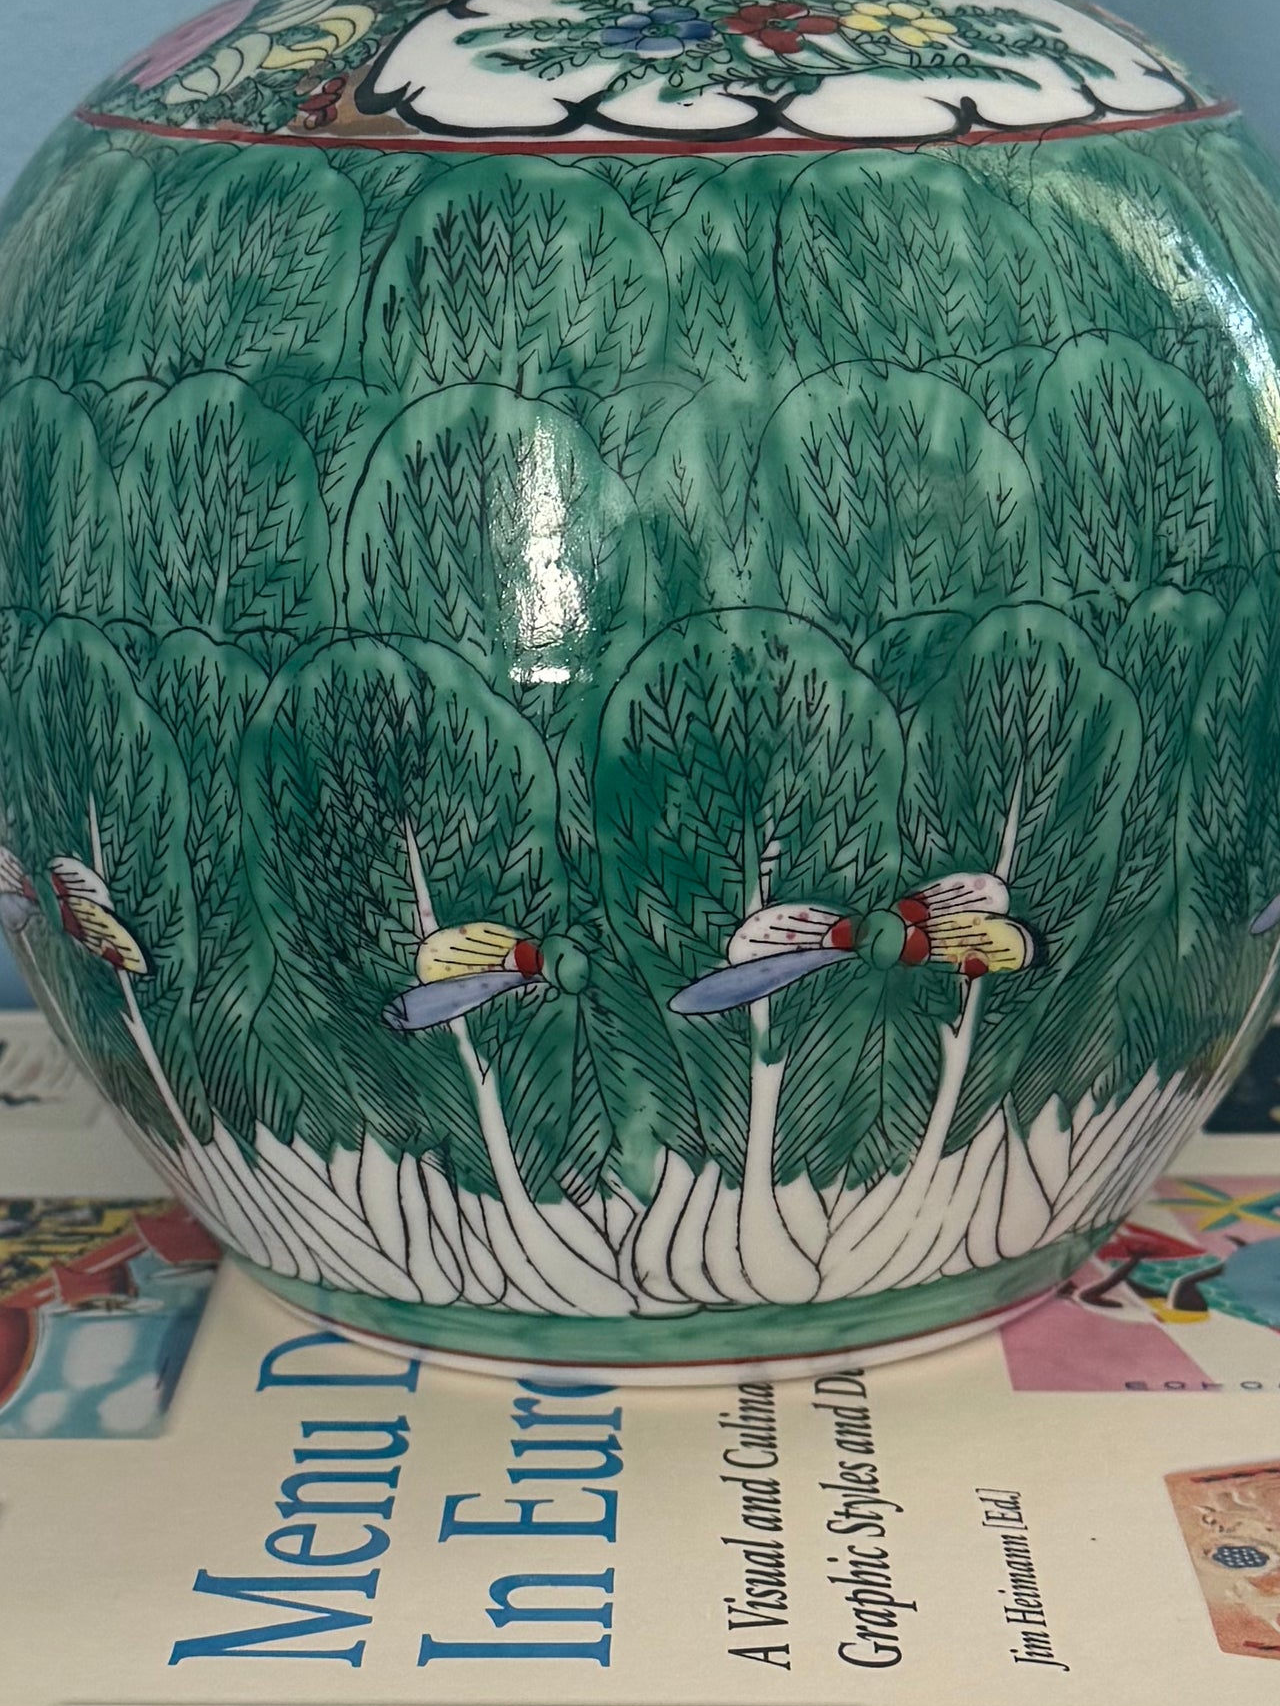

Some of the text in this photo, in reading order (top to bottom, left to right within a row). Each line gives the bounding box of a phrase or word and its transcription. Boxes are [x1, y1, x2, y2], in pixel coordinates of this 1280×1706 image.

[811, 1402, 875, 1453] and
[818, 1460, 904, 1537] Styles
[167, 1416, 411, 1667] Menu
[416, 1379, 624, 1667] In Eur
[718, 1382, 791, 1670] A Visual and Culina
[826, 1545, 917, 1668] Graphic
[975, 1487, 1070, 1671] Jim Heimann [Ed.]
